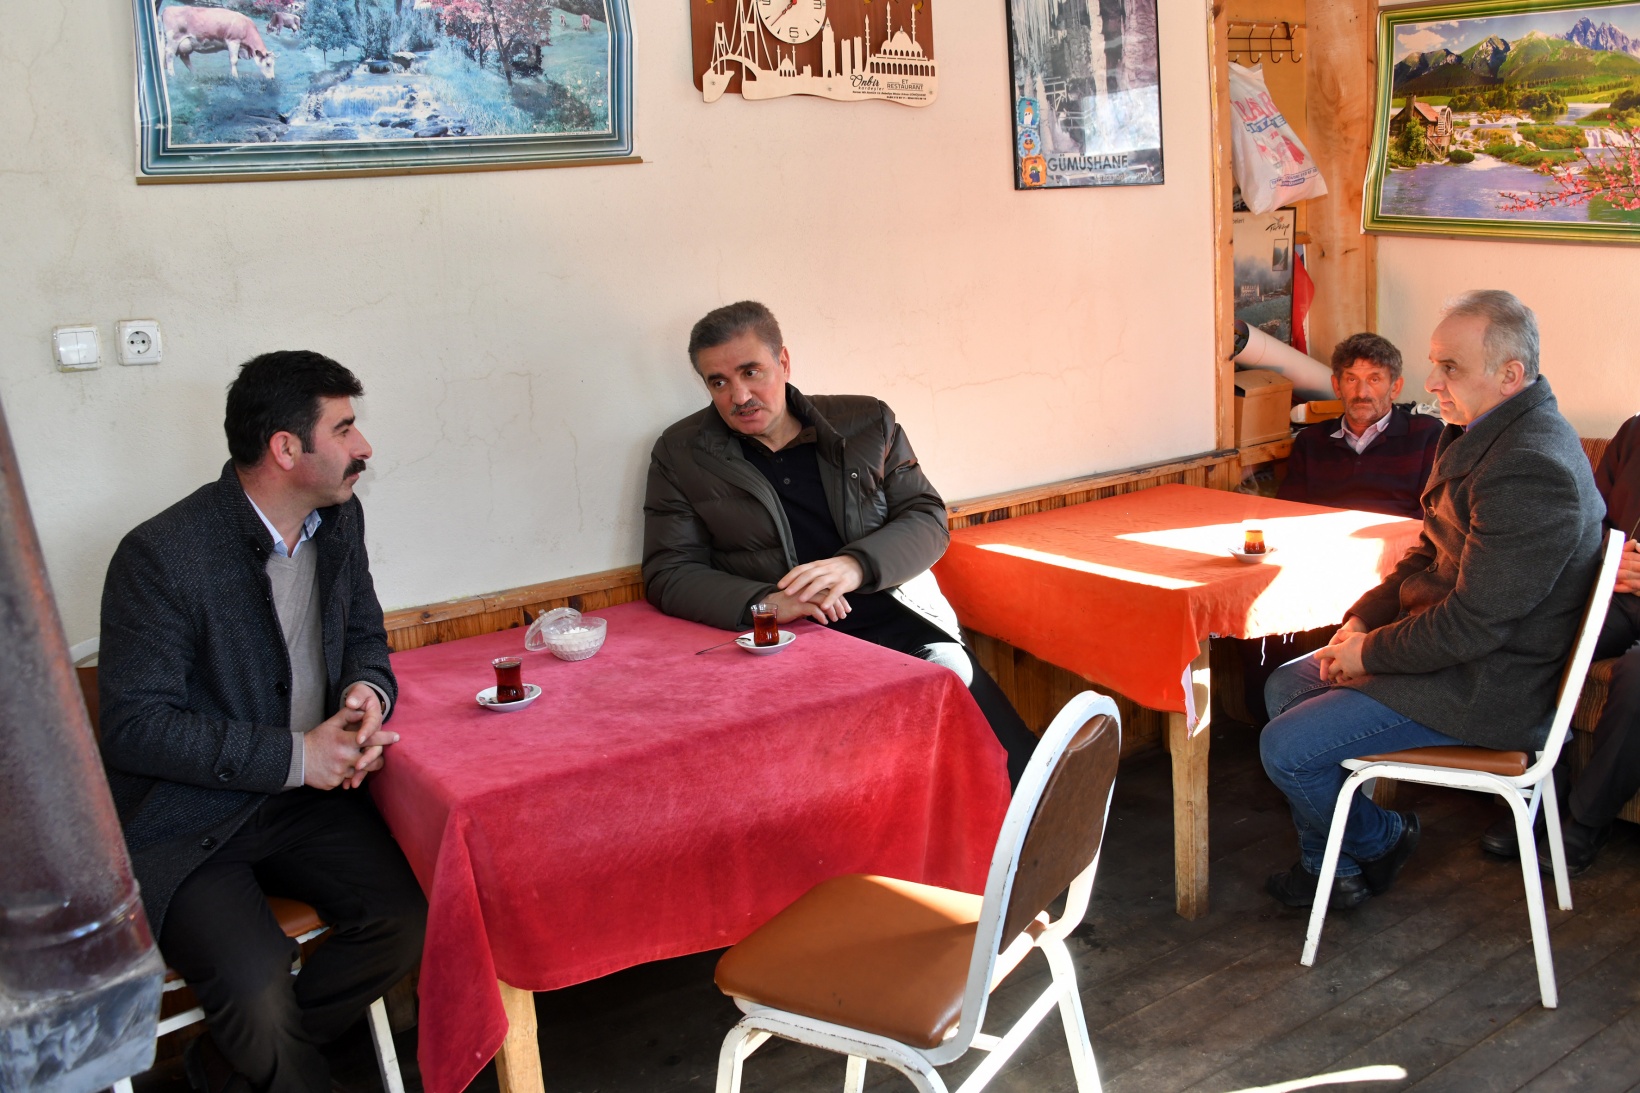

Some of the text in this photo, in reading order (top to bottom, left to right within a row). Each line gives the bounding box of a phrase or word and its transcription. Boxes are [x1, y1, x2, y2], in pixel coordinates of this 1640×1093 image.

[789, 27, 799, 38] 6
[850, 75, 879, 87] Onbir
[1047, 154, 1128, 172] GÜMÜŞHANE
